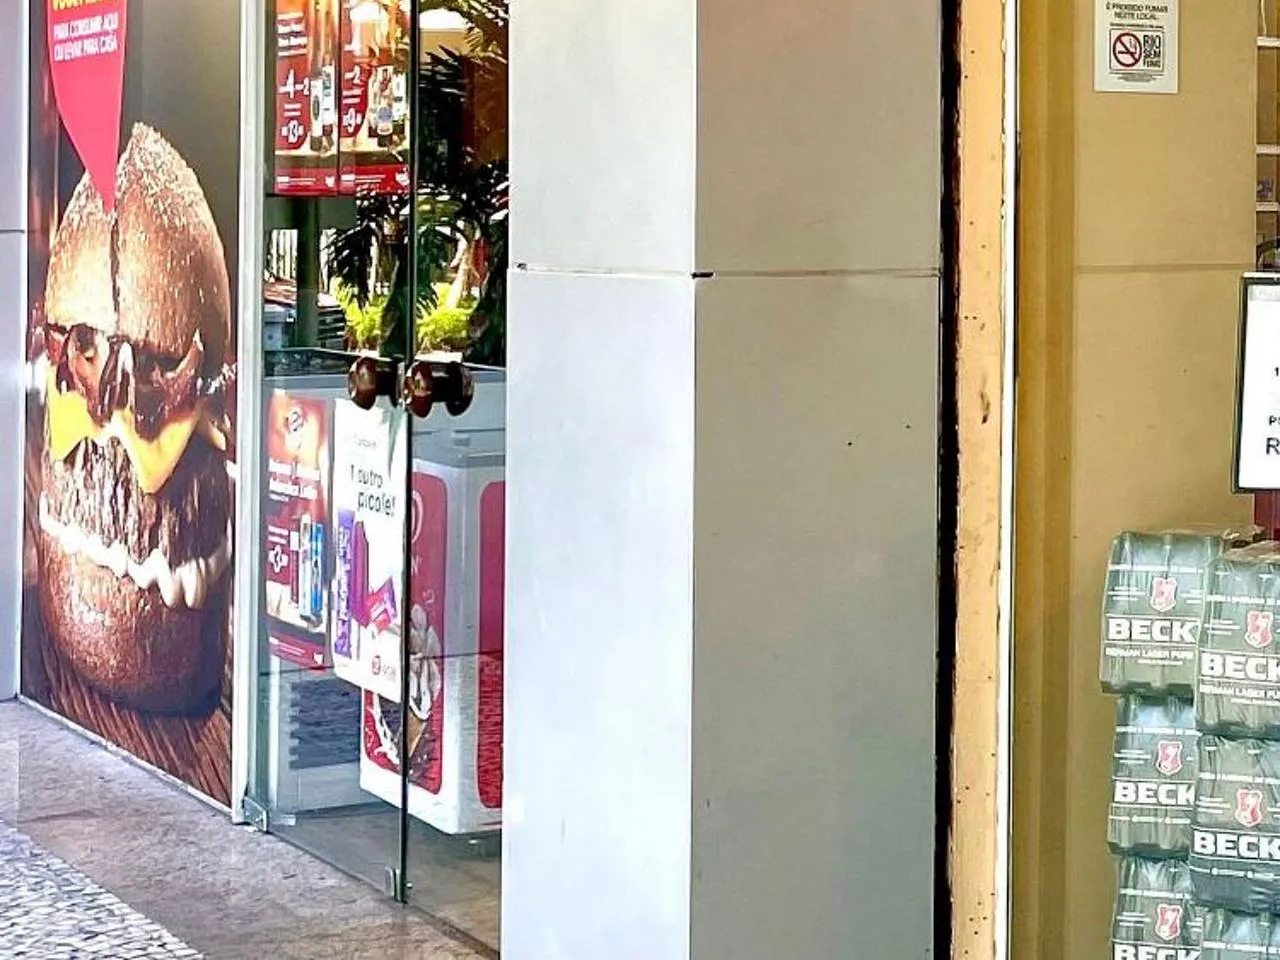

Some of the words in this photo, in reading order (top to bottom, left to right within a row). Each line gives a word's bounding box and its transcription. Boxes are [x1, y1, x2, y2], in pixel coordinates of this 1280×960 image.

[1274, 367, 1279, 377] 1
[358, 468, 383, 489] outro
[1108, 618, 1199, 643] BECK
